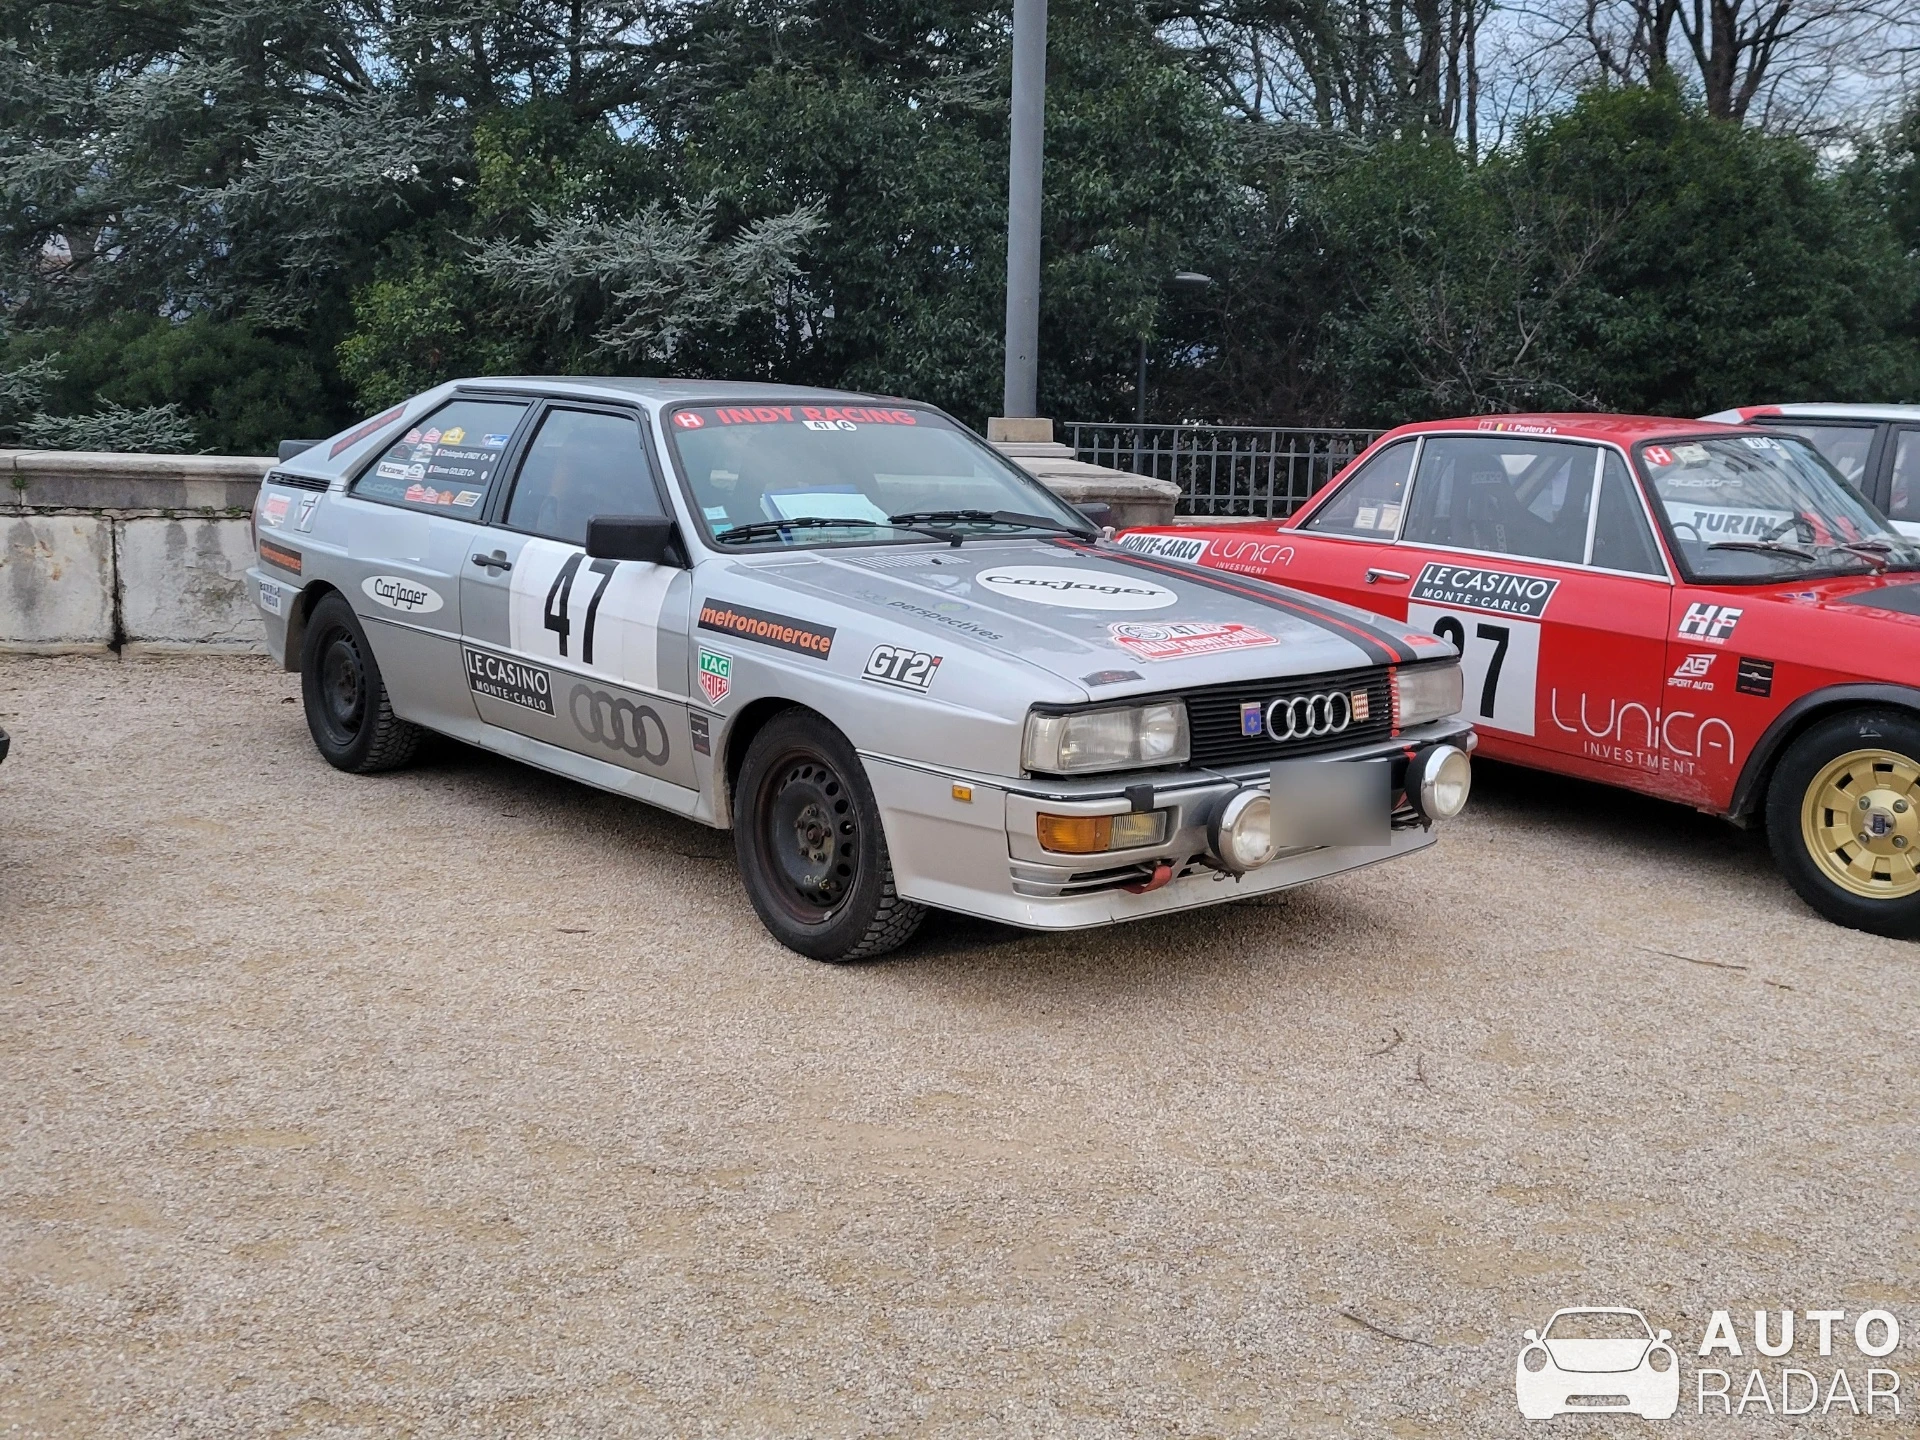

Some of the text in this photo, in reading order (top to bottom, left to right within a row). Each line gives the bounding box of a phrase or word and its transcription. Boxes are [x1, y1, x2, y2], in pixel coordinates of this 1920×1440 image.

[677, 414, 702, 427] H
[716, 406, 916, 425] INDY RACING
[814, 421, 830, 430] 47
[1514, 424, 1544, 434] Peeters
[1648, 447, 1671, 463] H
[1694, 511, 1776, 536] TURIN
[1120, 535, 1202, 560] MONTE-CARLO
[1216, 561, 1268, 574] INVESTMENT
[374, 577, 428, 610] CarJager
[985, 575, 1167, 598] CarJager
[1422, 565, 1549, 600] LE CASINO
[544, 552, 620, 665] 47
[888, 601, 1004, 640] perspectives
[1678, 602, 1744, 637] HF
[700, 604, 833, 654] metronomerace
[1170, 625, 1197, 636] 47
[468, 651, 548, 696] LE CASINO
[702, 653, 728, 676] TAG
[867, 644, 943, 688] GT2i
[701, 672, 727, 698] HEUER
[1667, 677, 1714, 691] SPORT AUTO
[1584, 740, 1696, 776] INVESTMENT
